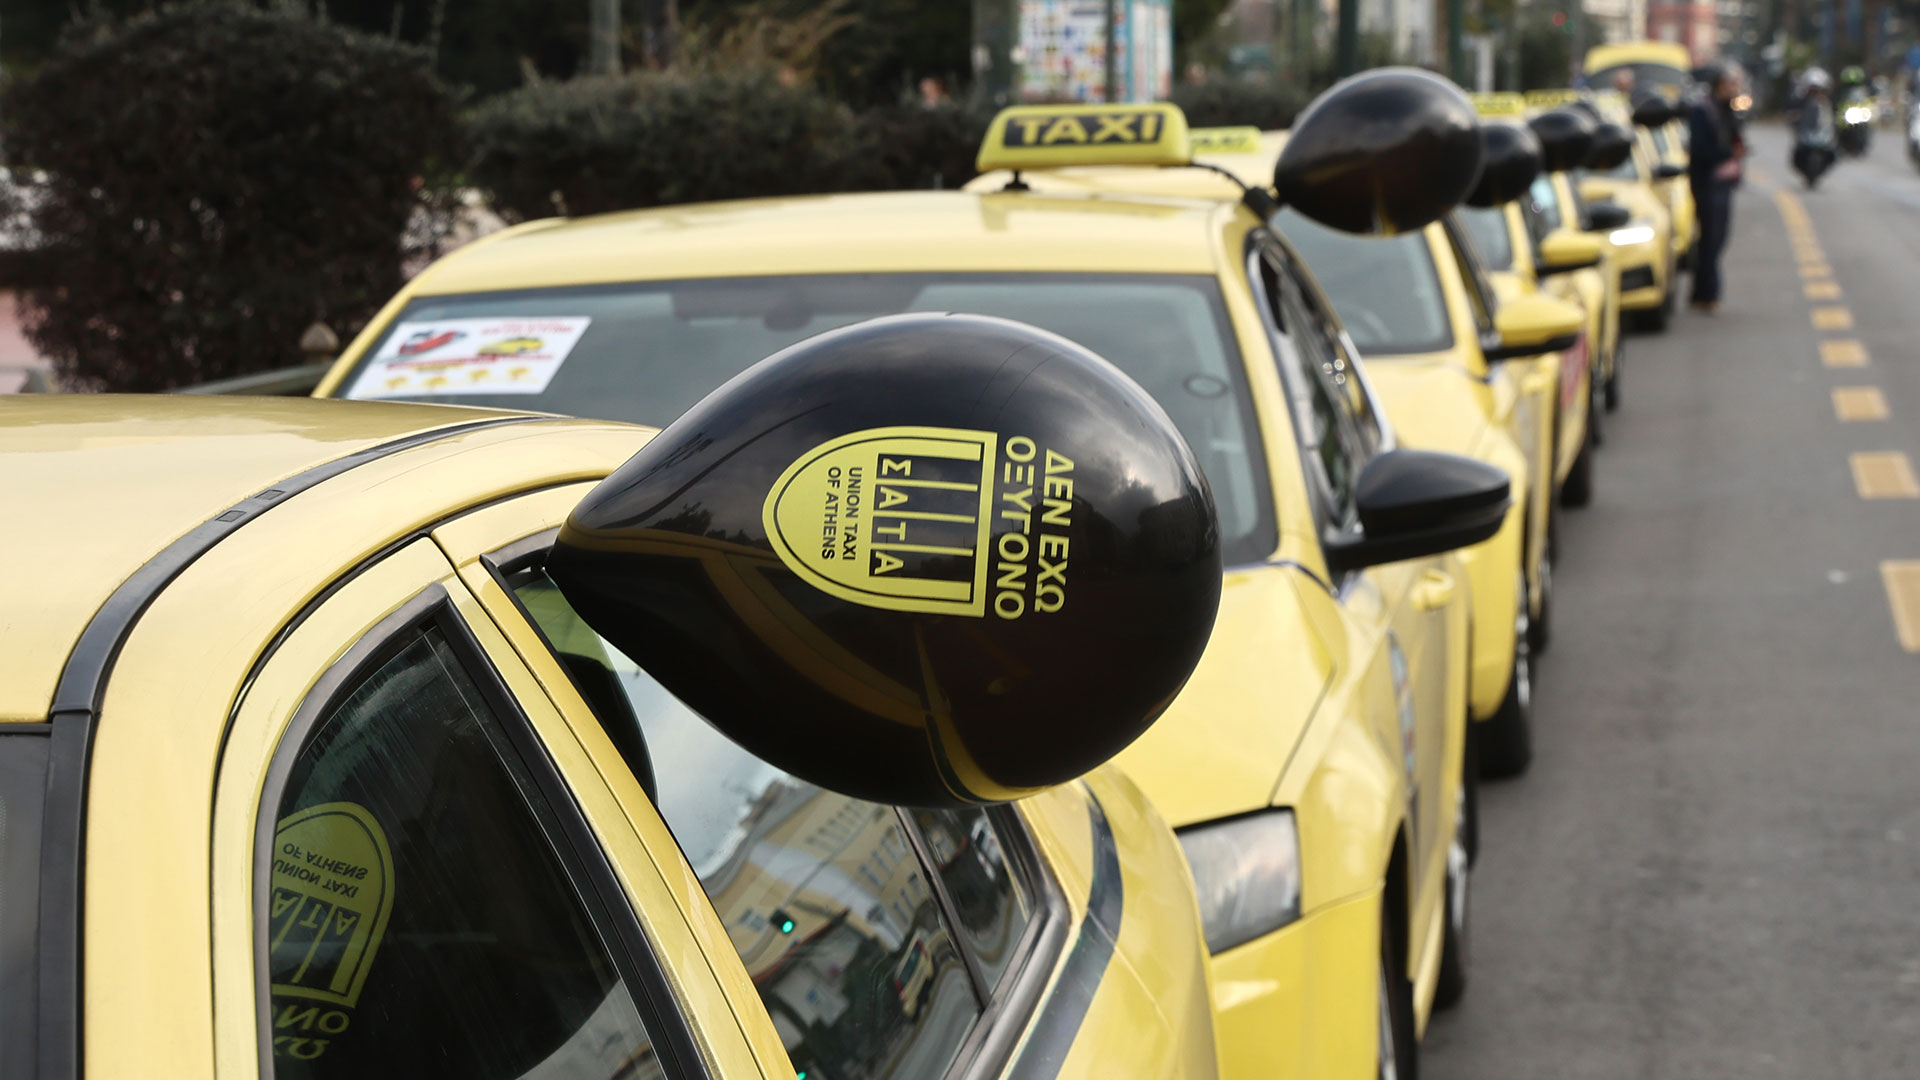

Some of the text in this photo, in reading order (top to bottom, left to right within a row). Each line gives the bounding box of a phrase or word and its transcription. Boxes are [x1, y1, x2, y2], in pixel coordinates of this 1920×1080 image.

[1014, 113, 1159, 145] TAXI
[822, 466, 841, 560] OF ATHENS
[842, 466, 863, 560] UNION TAXI
[994, 435, 1037, 620] ΟΞΥΓΟΝΟ
[1034, 448, 1075, 613] ΔΕΝ ΕΧΩ
